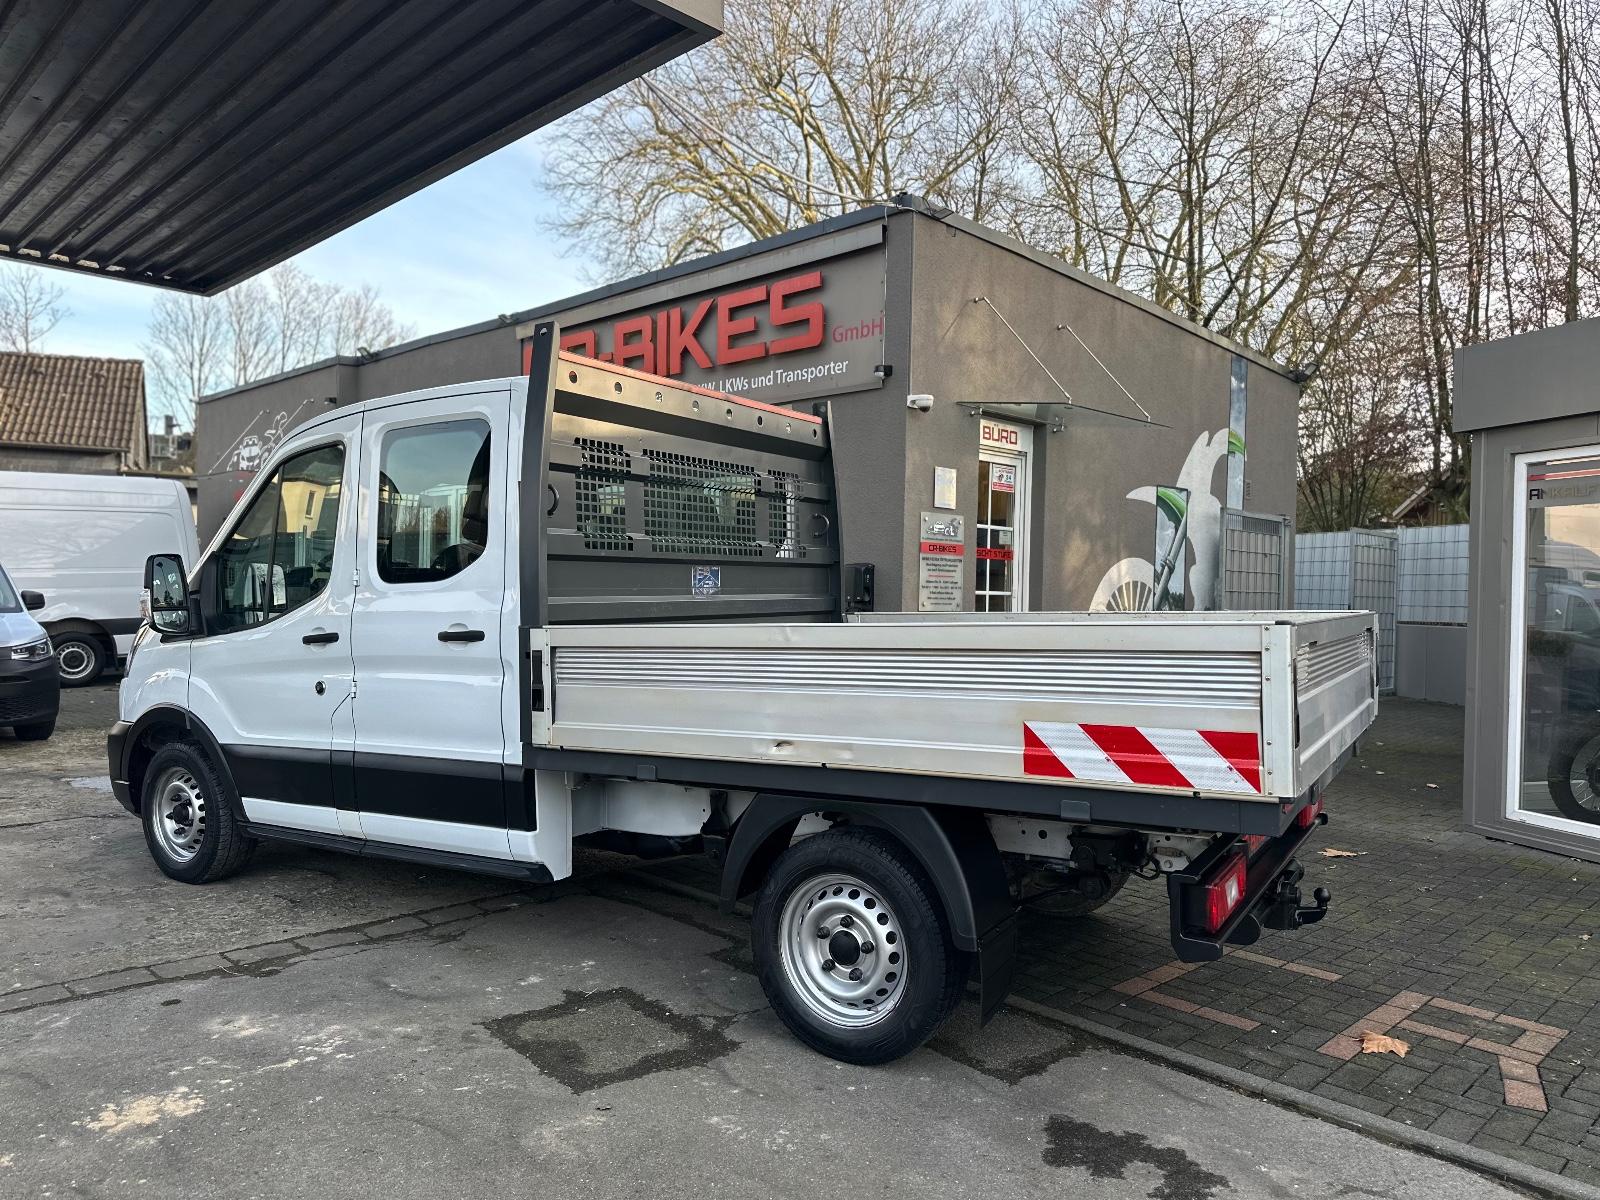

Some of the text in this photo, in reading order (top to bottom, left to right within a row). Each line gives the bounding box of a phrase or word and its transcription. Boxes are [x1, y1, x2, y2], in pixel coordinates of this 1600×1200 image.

[522, 271, 824, 380] -BIKES
[832, 318, 884, 343] GmbH
[719, 376, 749, 393] LKWs
[751, 370, 774, 389] und
[775, 360, 849, 384] Transporter
[982, 423, 1018, 445] BÜRO
